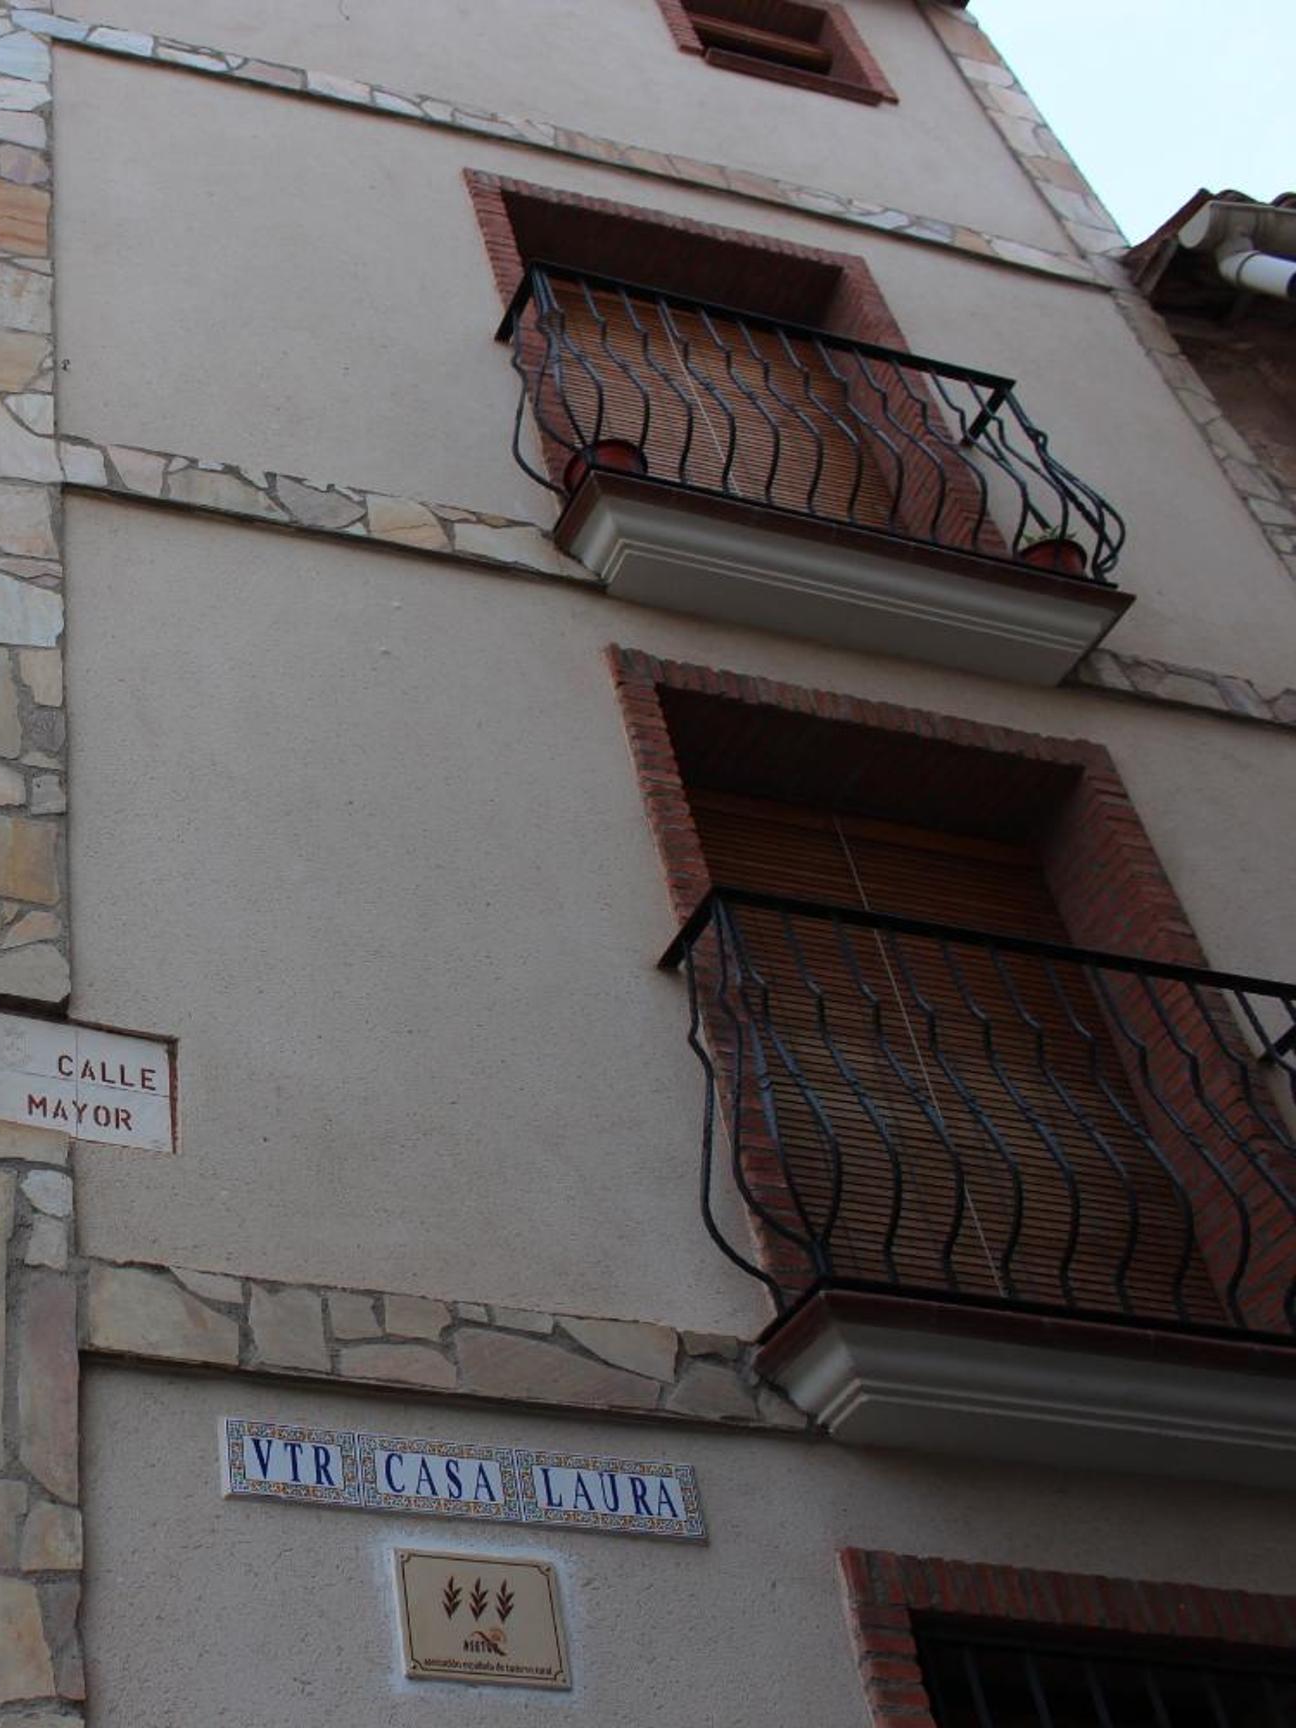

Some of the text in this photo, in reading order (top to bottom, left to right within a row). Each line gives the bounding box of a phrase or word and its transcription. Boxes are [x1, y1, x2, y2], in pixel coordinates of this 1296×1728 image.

[57, 1055, 157, 1091] CALLE
[27, 1094, 133, 1131] MAYOR
[251, 1438, 679, 1517] VTR CASA LAURA
